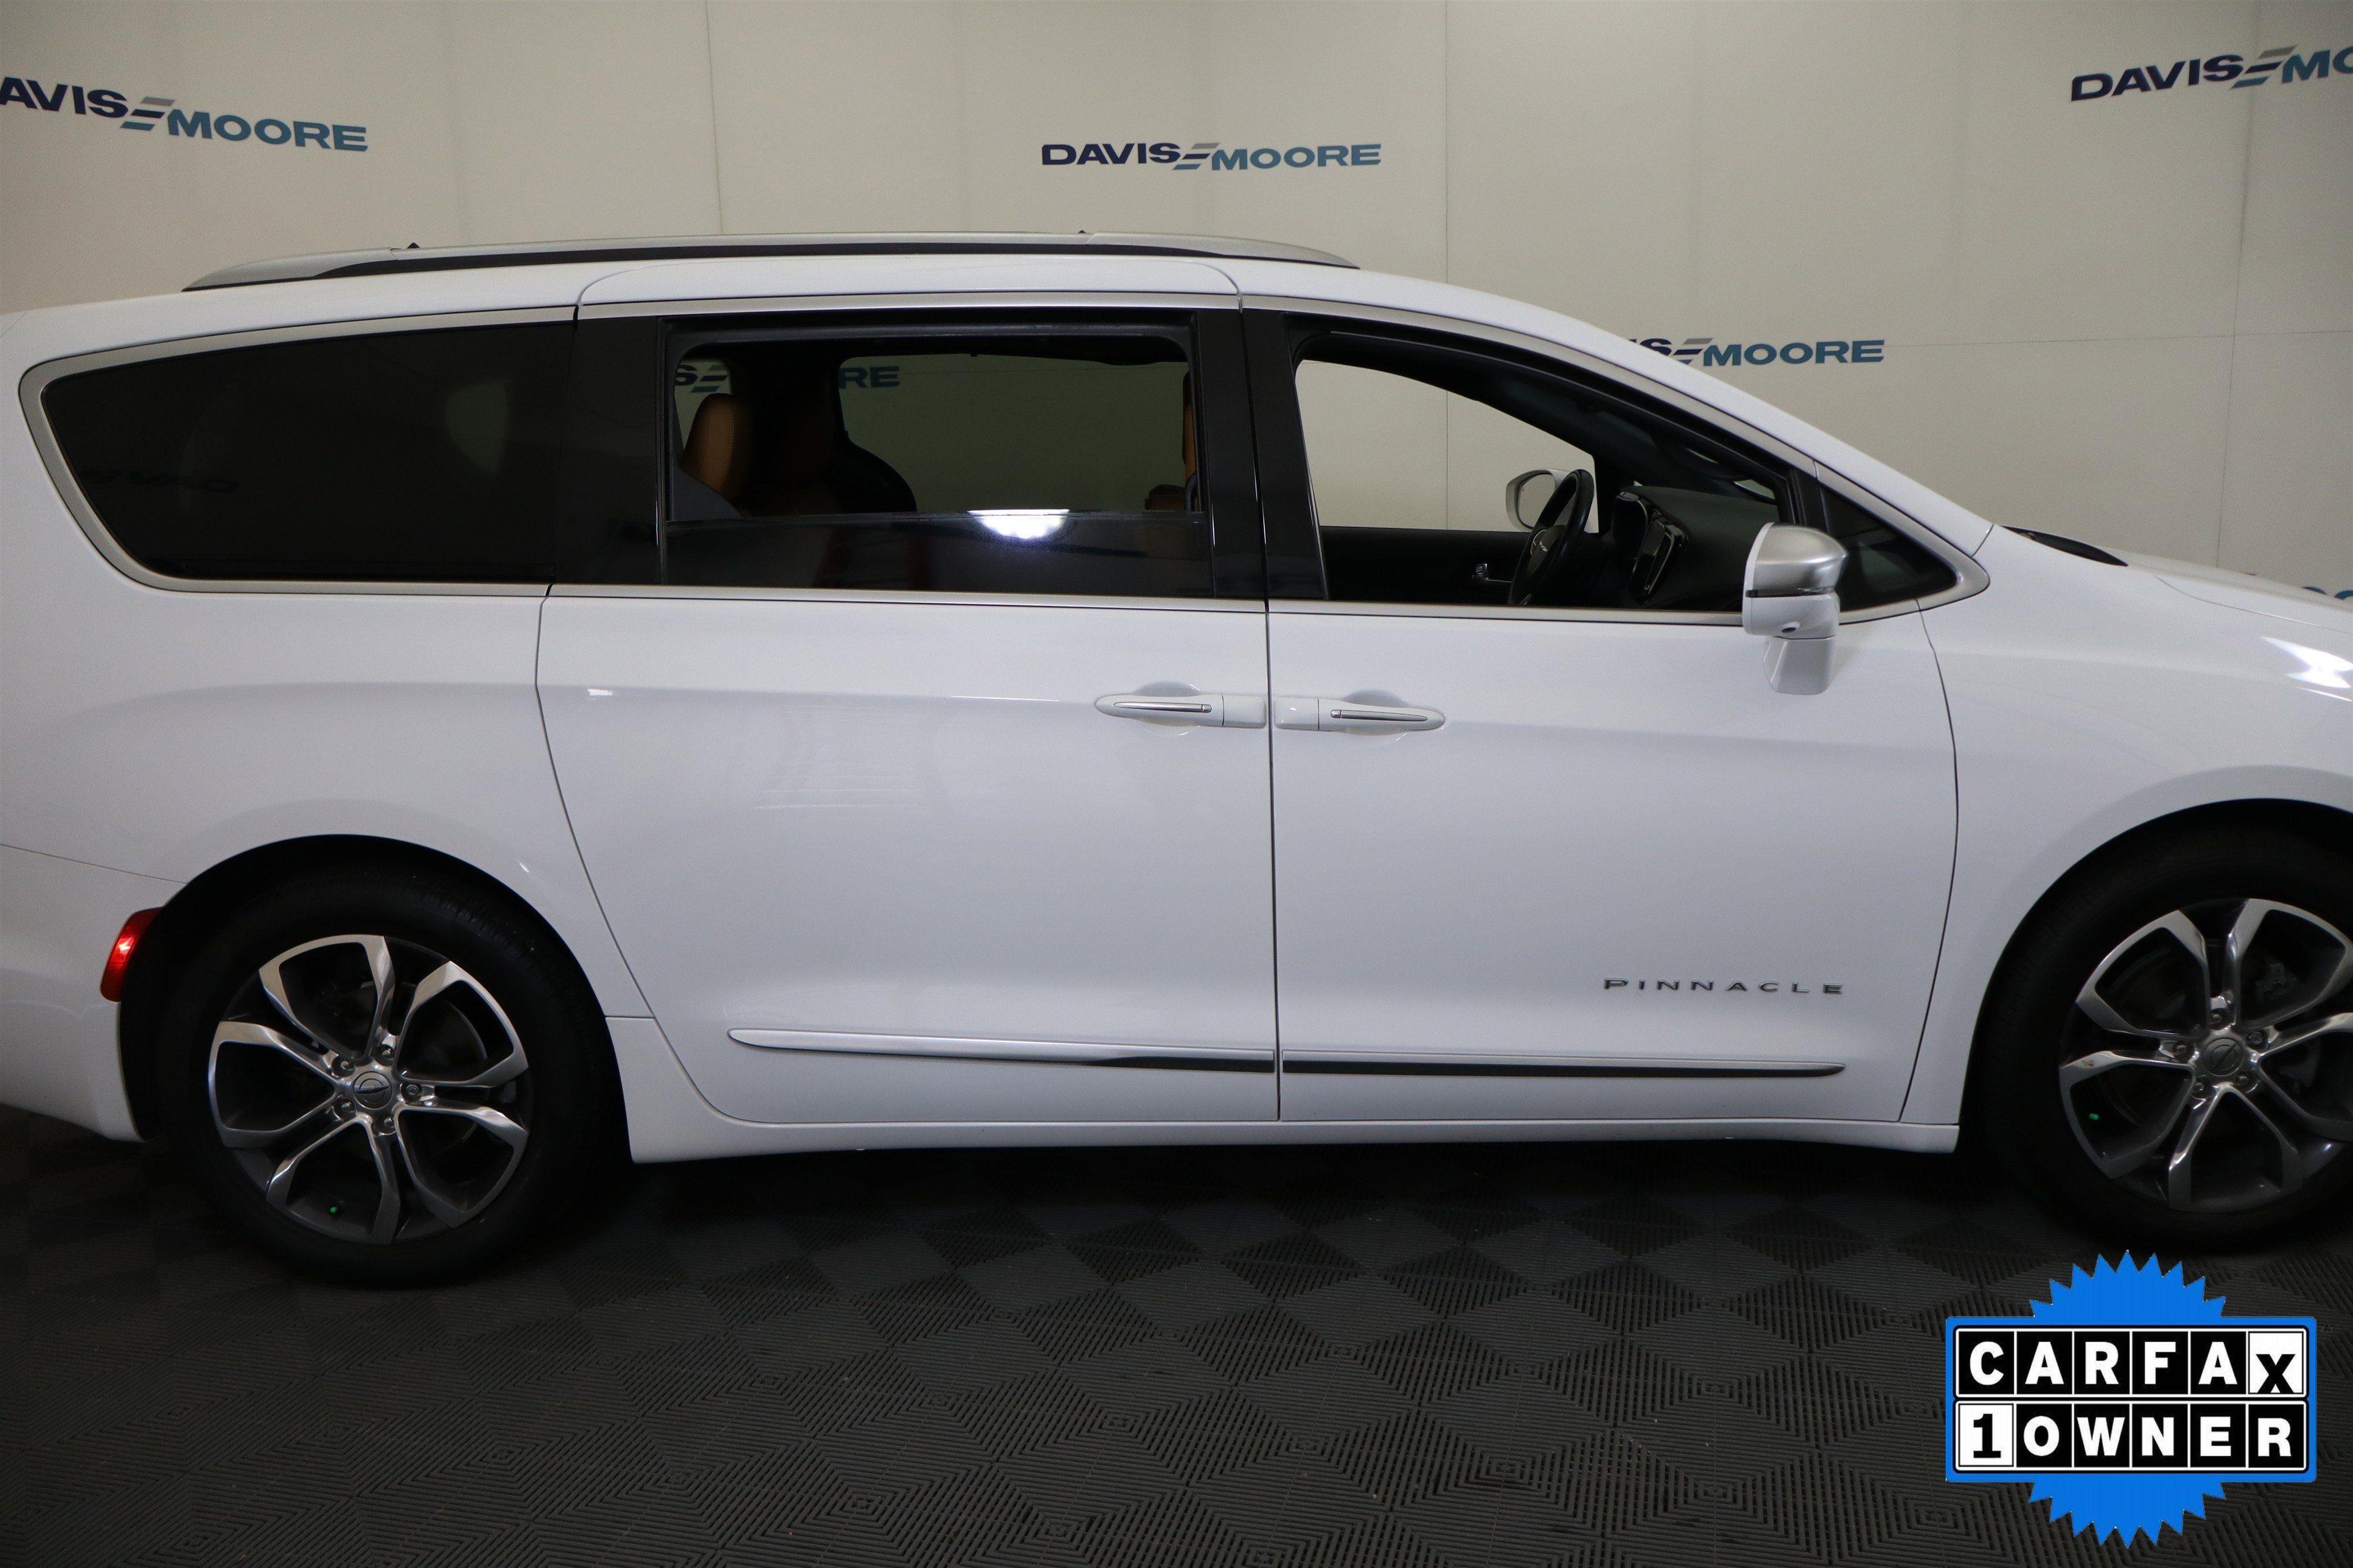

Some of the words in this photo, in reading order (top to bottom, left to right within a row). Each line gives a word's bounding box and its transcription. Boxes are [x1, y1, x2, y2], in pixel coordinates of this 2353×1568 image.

[2070, 55, 2244, 102] DAVIS
[167, 109, 368, 152] MOORE
[1042, 142, 1181, 165] DAVIS
[1212, 144, 1382, 171] MOORE
[1703, 339, 1885, 366] MOORE
[1604, 978, 1843, 994] PINNACLE
